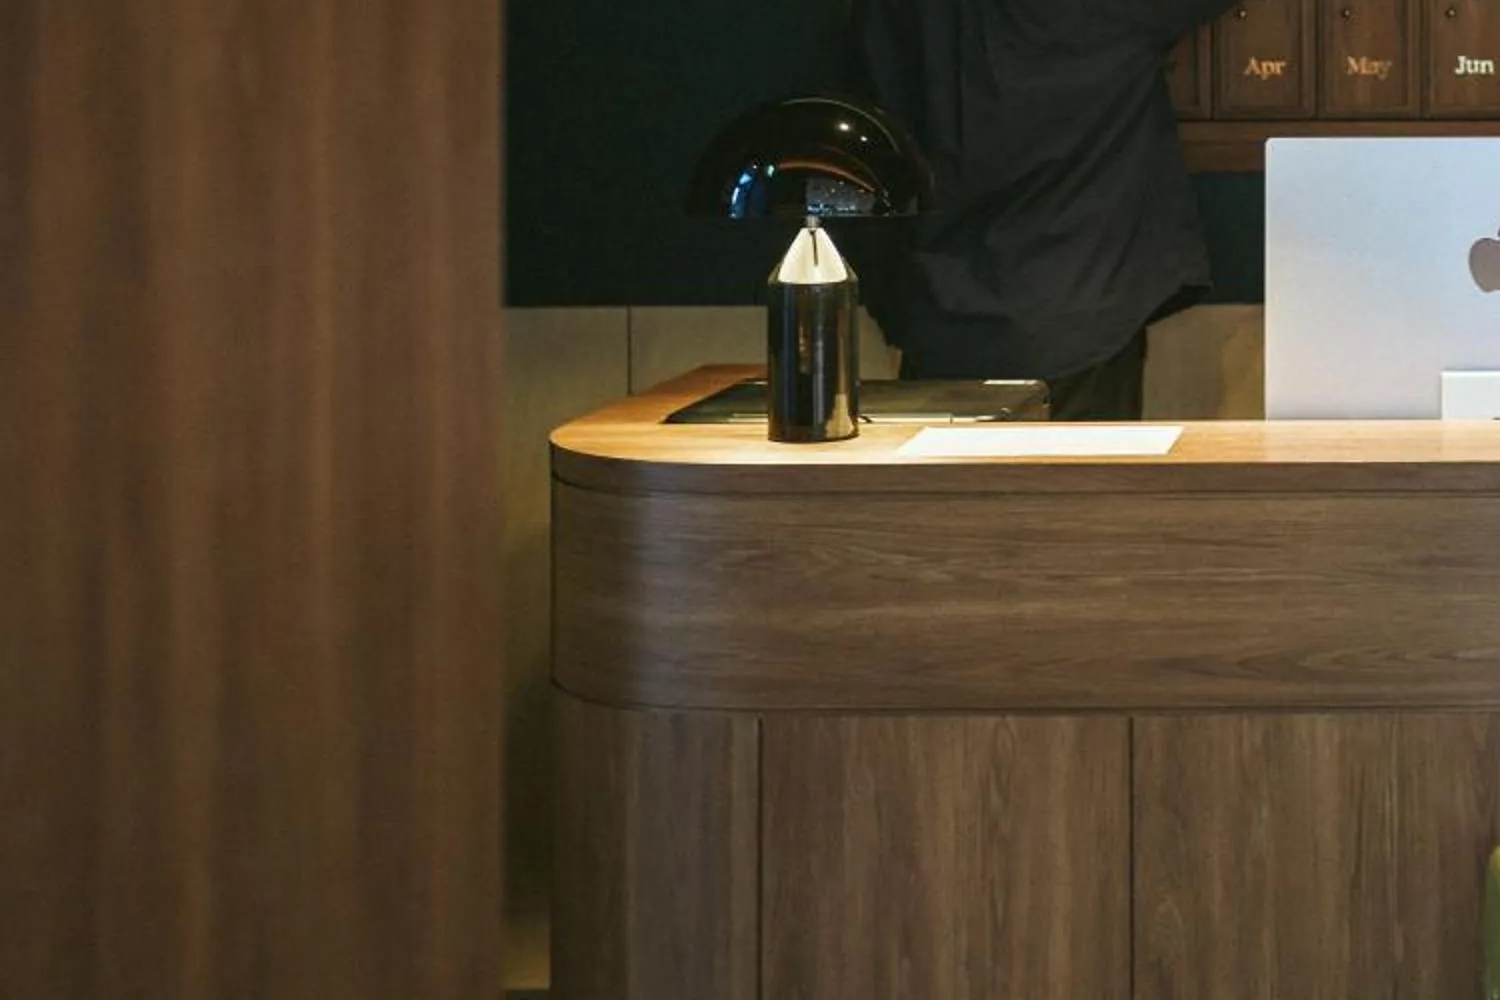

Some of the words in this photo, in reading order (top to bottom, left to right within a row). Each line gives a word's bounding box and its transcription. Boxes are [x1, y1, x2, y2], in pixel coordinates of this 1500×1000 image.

[1244, 56, 1286, 80] Apr
[1347, 56, 1392, 81] May
[1455, 55, 1495, 76] Jun
